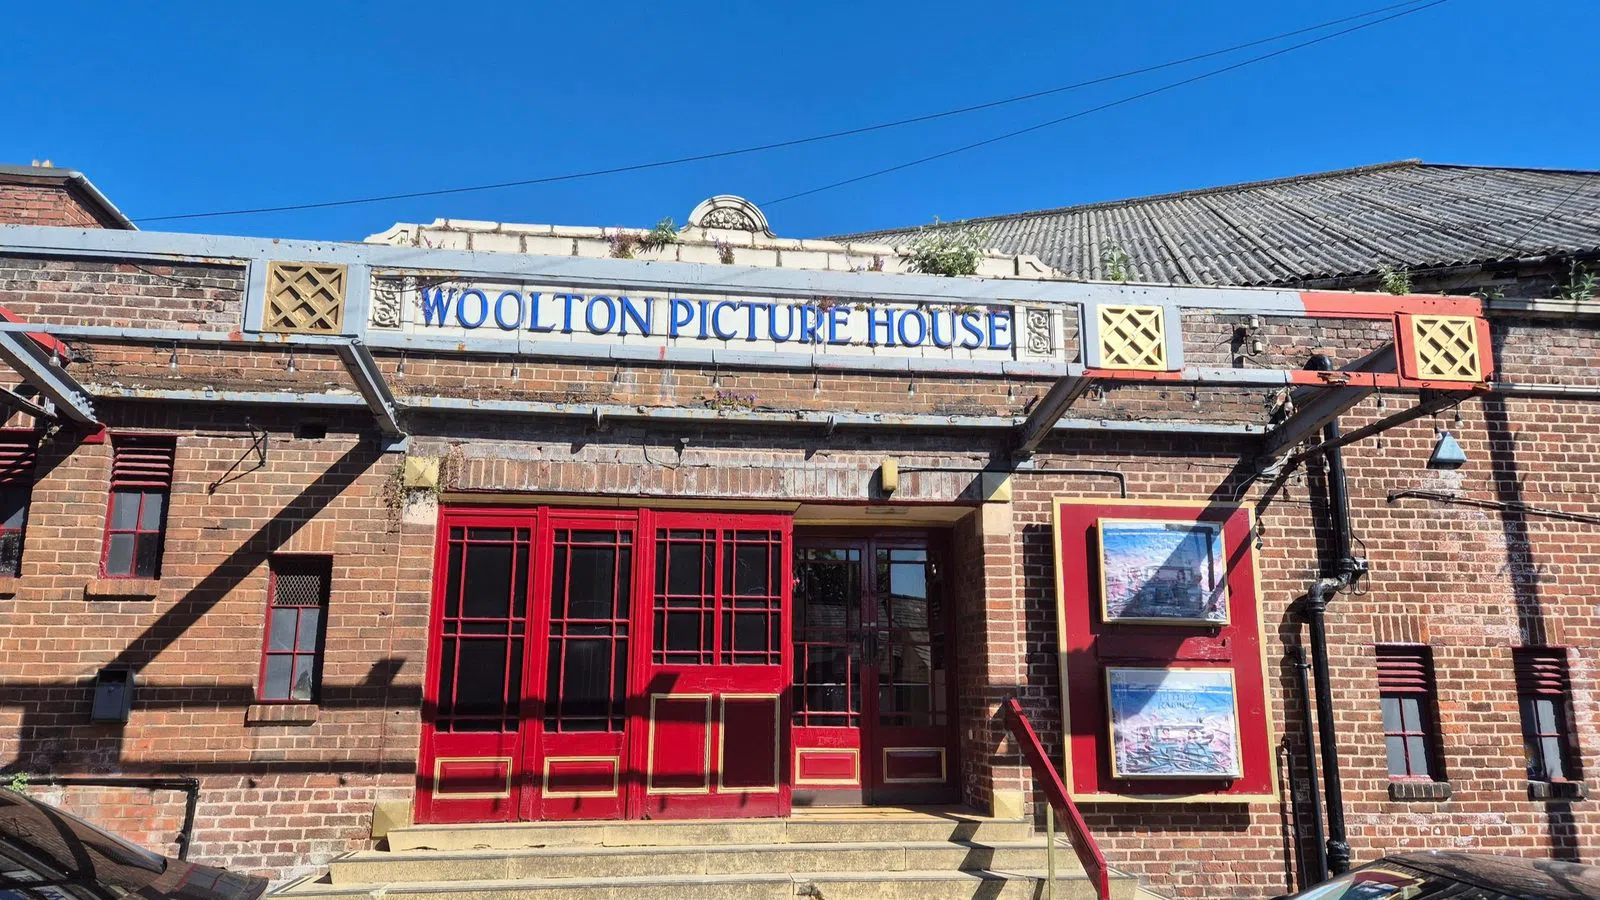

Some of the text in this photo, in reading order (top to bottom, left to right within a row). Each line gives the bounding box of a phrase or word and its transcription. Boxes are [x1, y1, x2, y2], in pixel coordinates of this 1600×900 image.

[420, 286, 1012, 350] WOOLTON PICTURE HOUSE
